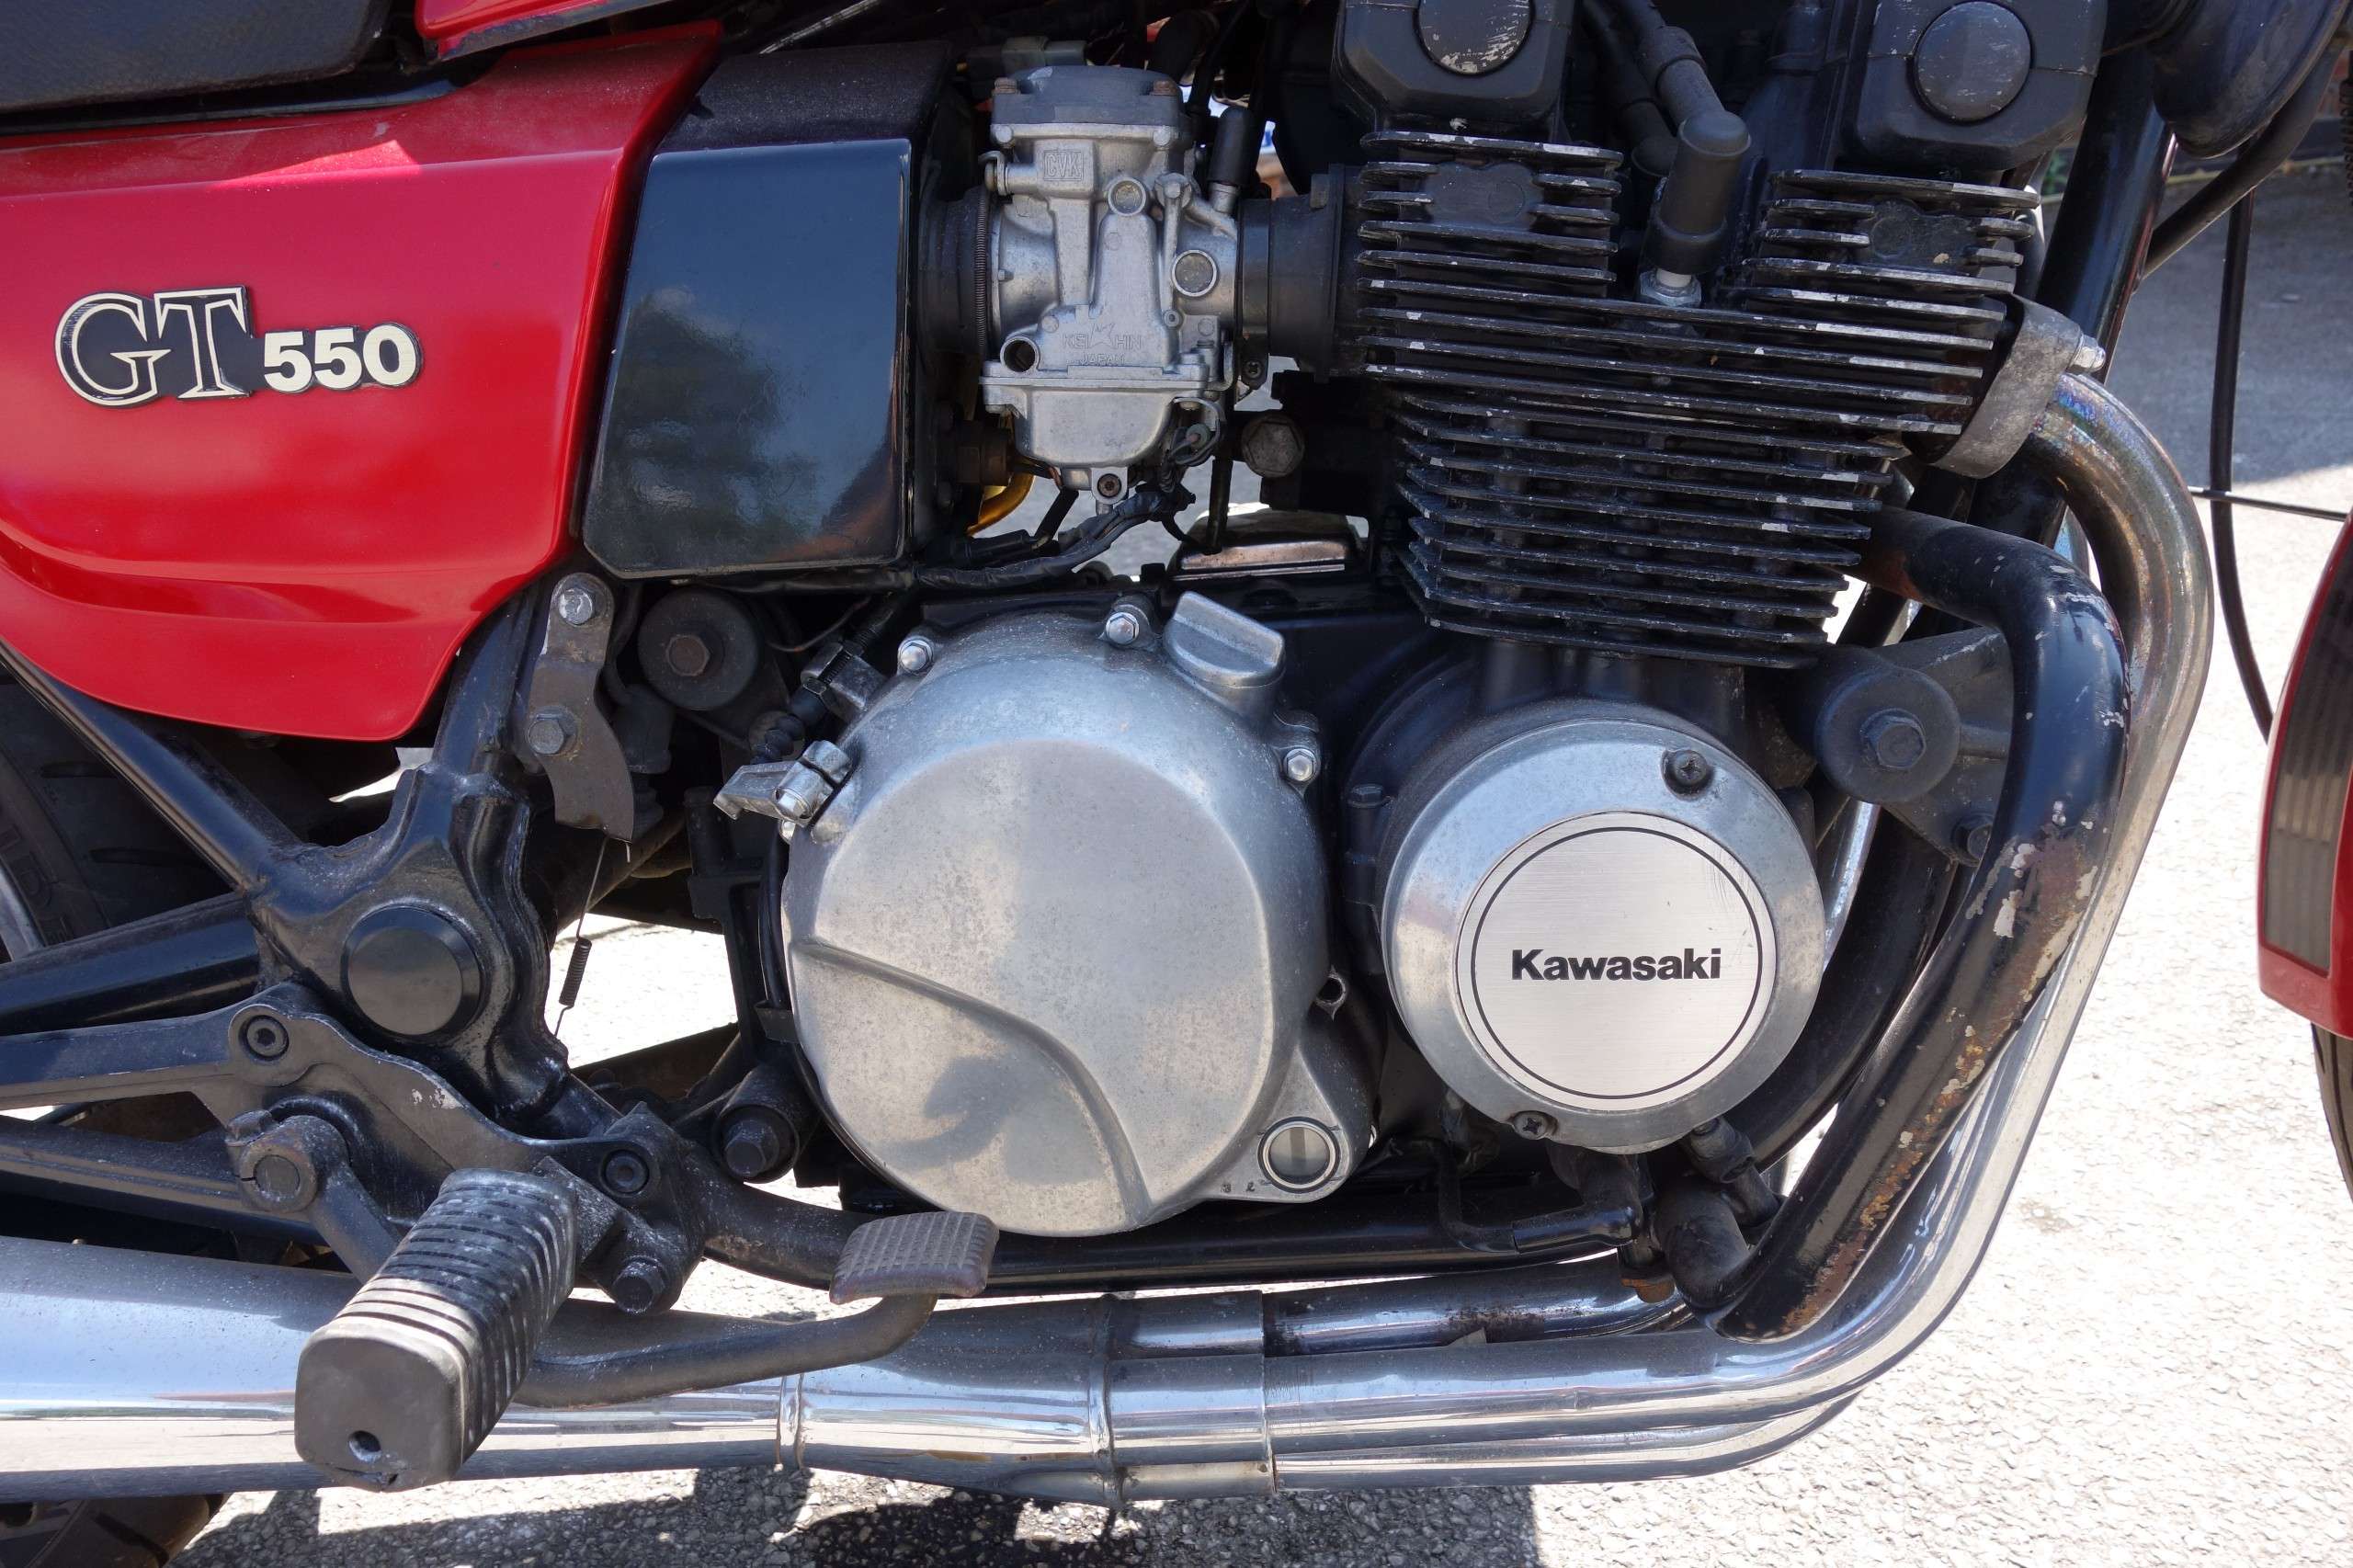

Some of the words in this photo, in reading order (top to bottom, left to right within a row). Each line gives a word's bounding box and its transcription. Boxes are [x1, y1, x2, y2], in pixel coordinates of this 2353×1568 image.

[1045, 153, 1083, 177] CVK
[54, 286, 255, 406] GT
[263, 322, 418, 394] 550
[1511, 948, 1722, 981] Kawasaki
